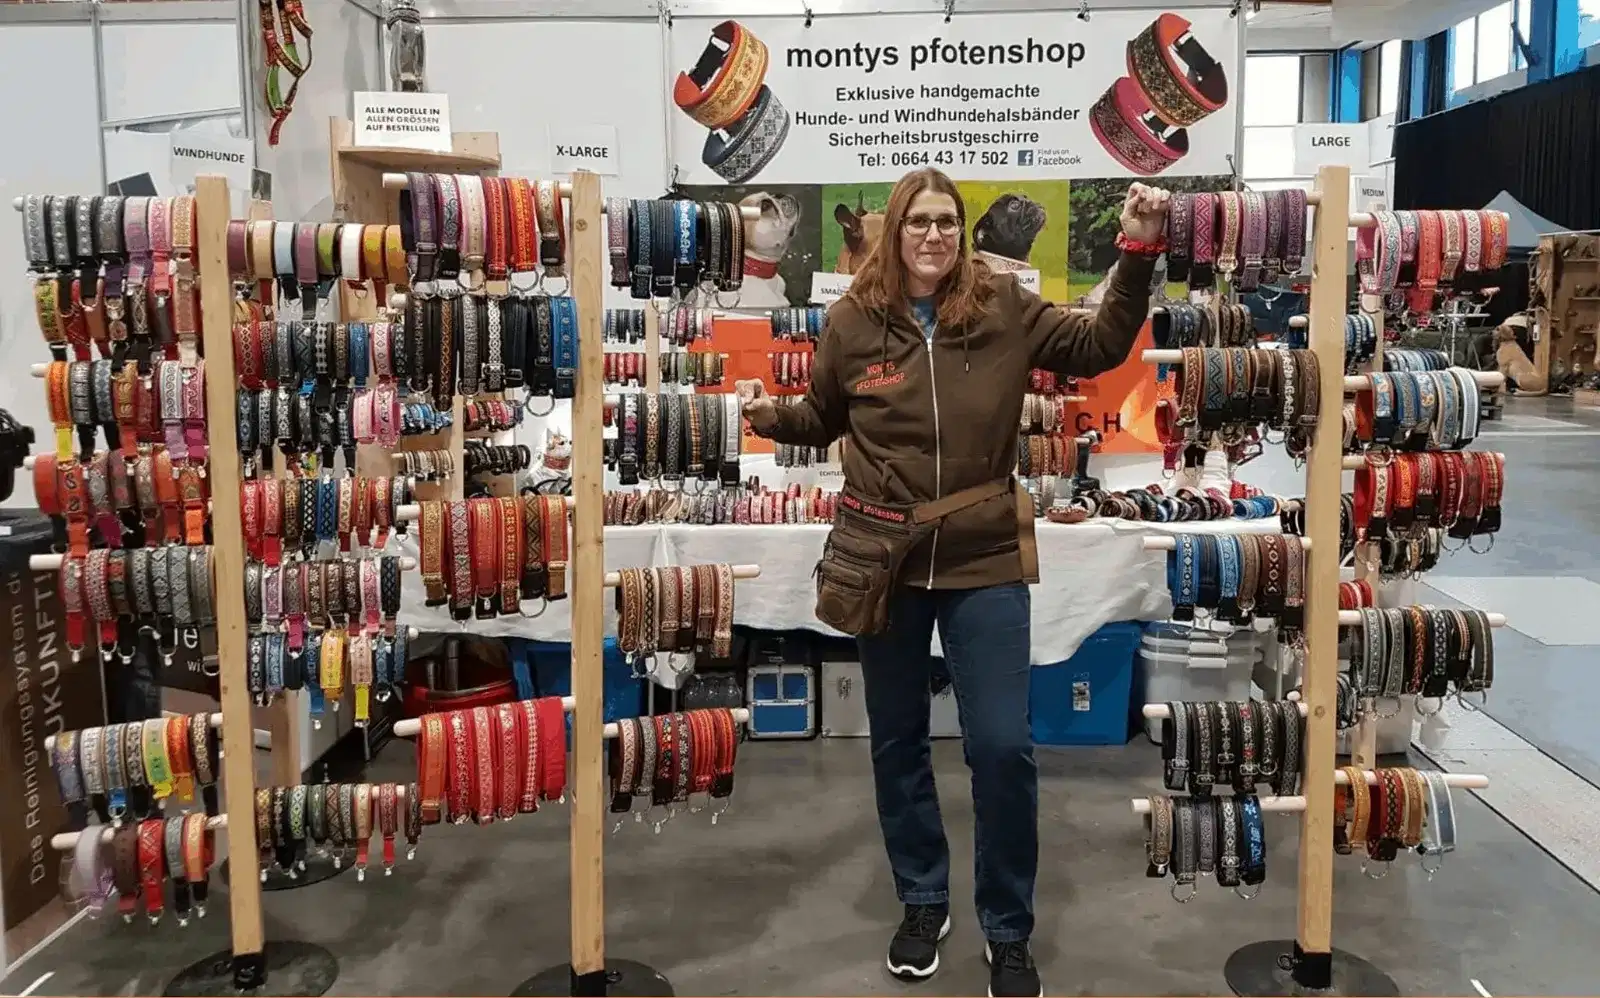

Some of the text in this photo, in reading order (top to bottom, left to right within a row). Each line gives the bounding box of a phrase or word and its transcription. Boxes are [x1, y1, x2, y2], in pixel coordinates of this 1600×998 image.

[786, 37, 1086, 73] montys pfotenshop
[836, 84, 1040, 102] Exklusive handgemachte
[366, 114, 439, 124] ALLEN GRÖSSEN
[387, 107, 427, 115] MODELLE
[795, 106, 1080, 125] Hunde- und Windhundehalsbänder
[828, 129, 1039, 147] Sicherheitsbrustgeschirre
[1311, 136, 1351, 147] LARGE
[173, 146, 245, 164] WINDHUNDE
[556, 145, 608, 158] X-LARGE
[857, 150, 1009, 167] Tel: 0664 43 17 502
[1037, 155, 1082, 166] Facebook
[1362, 188, 1385, 197] MEDIUM
[34, 572, 65, 767] UKUNFT!
[11, 603, 42, 829] Reinigungssystem
[29, 834, 46, 885] Das
